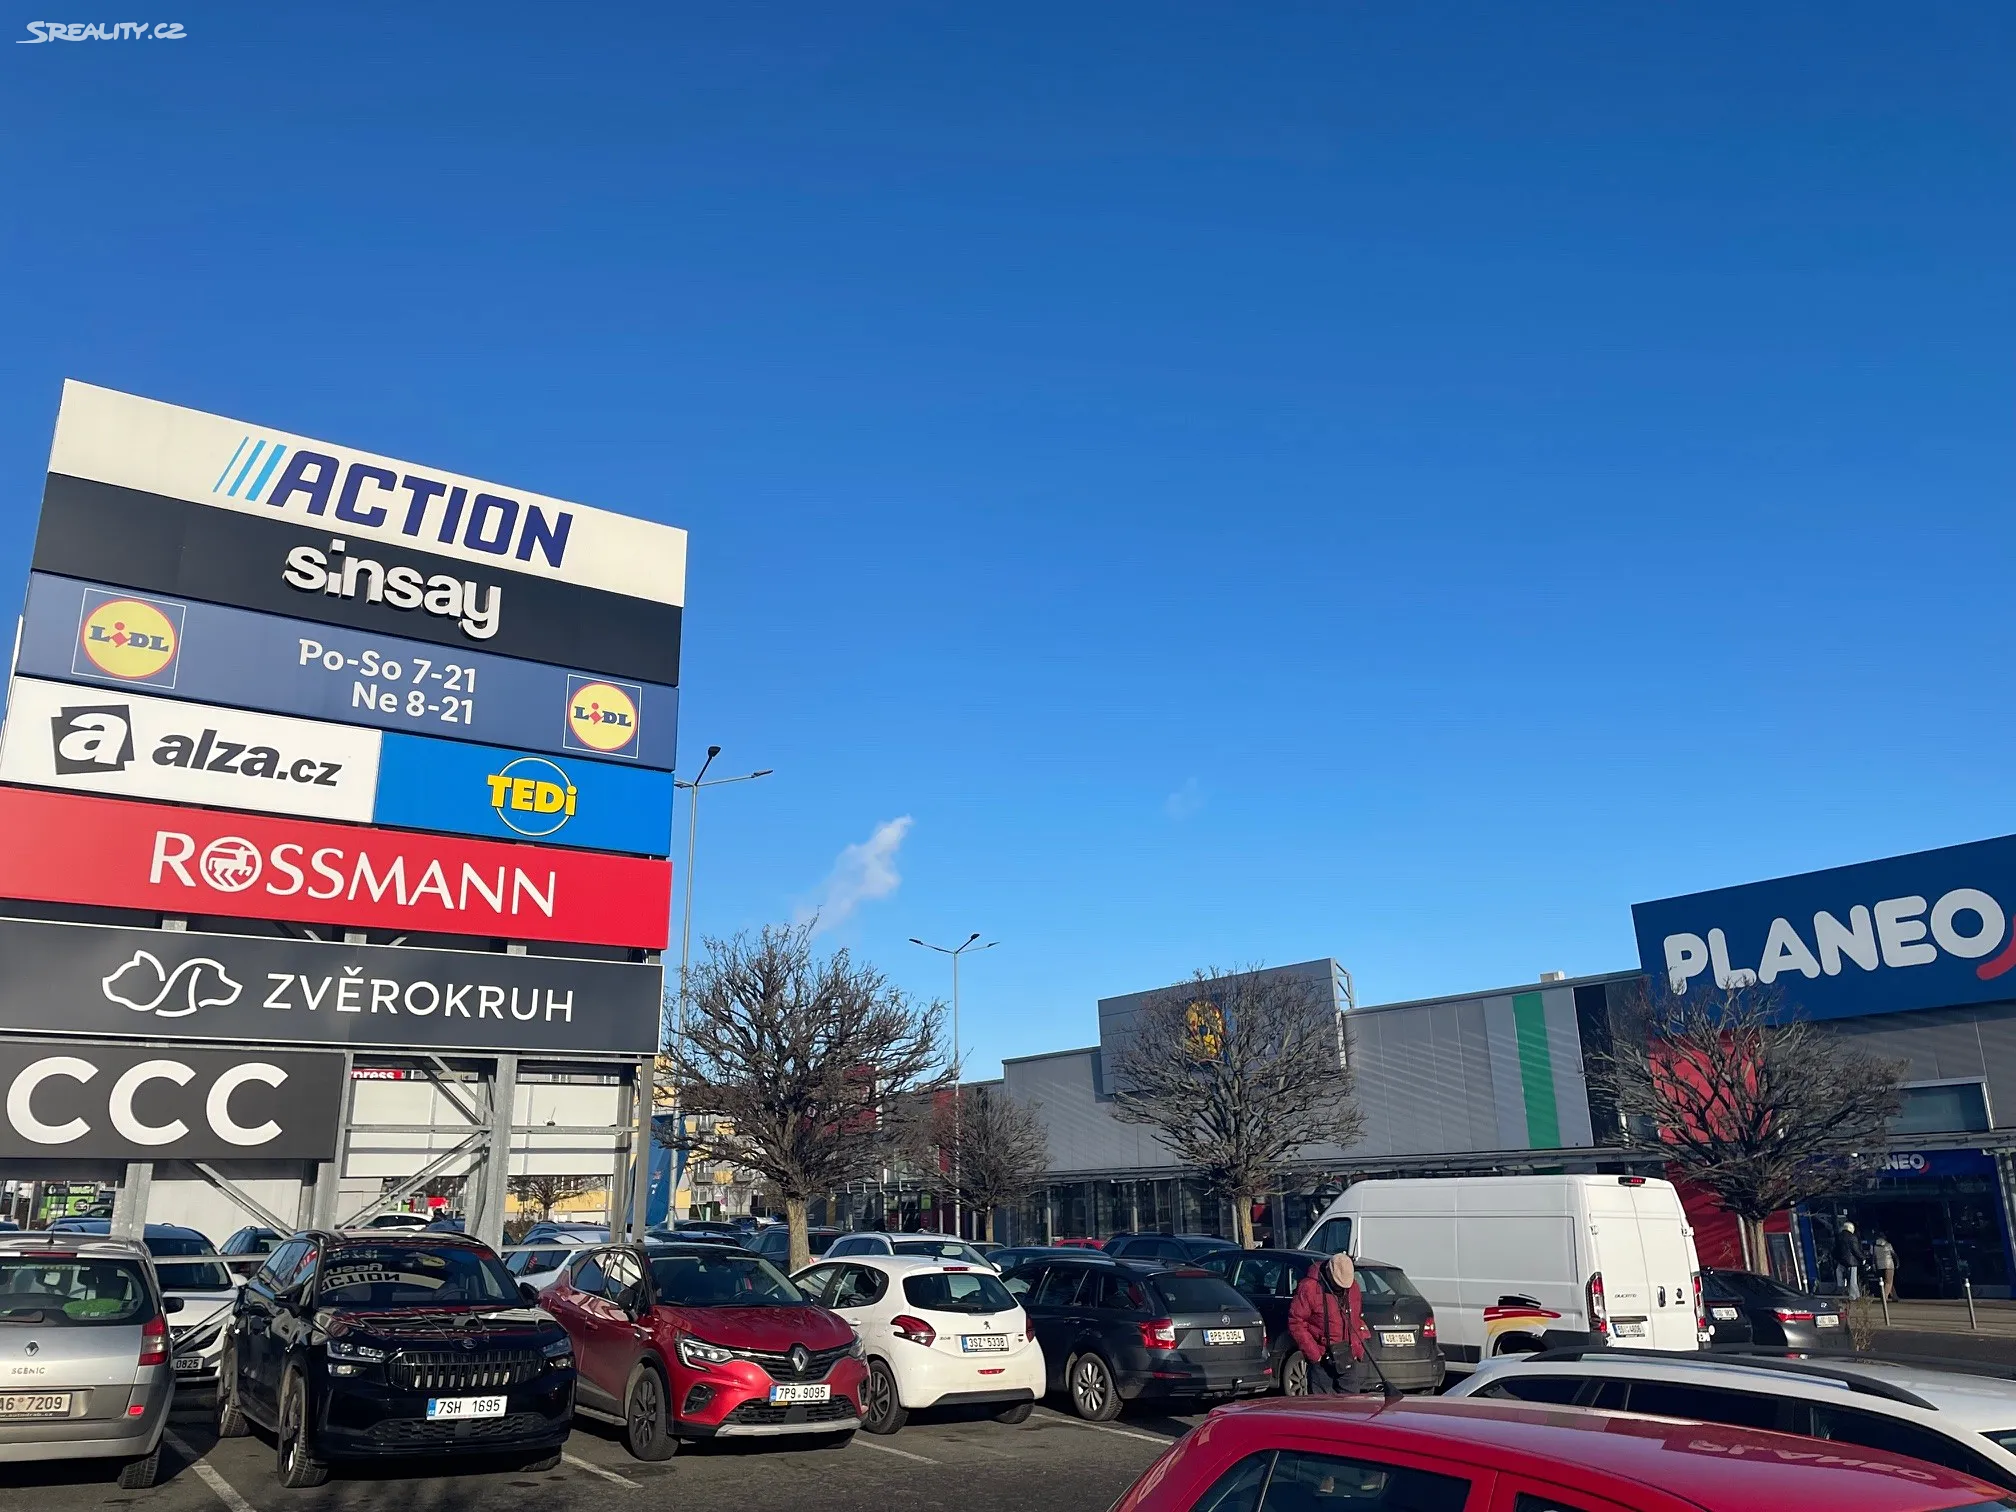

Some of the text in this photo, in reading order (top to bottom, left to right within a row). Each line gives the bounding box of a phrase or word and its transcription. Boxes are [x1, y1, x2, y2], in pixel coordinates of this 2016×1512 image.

[266, 450, 573, 568] ACTION
[282, 539, 501, 639] sinsay
[299, 638, 476, 693] Po-So 7-21
[352, 681, 473, 724] Ne 8-21
[152, 728, 342, 786] alza.cz
[149, 831, 556, 918] ROSSMANN
[1663, 888, 2006, 996] PLANEO
[263, 966, 573, 1022] ZVĚROKRUH
[6, 1056, 289, 1146] CCC
[11, 1367, 45, 1375] SCENIC
[176, 1360, 199, 1369] 0825
[25, 1396, 63, 1411] 7209
[438, 1399, 501, 1414] 7SH 1695
[778, 1386, 826, 1400] 7P9 9095
